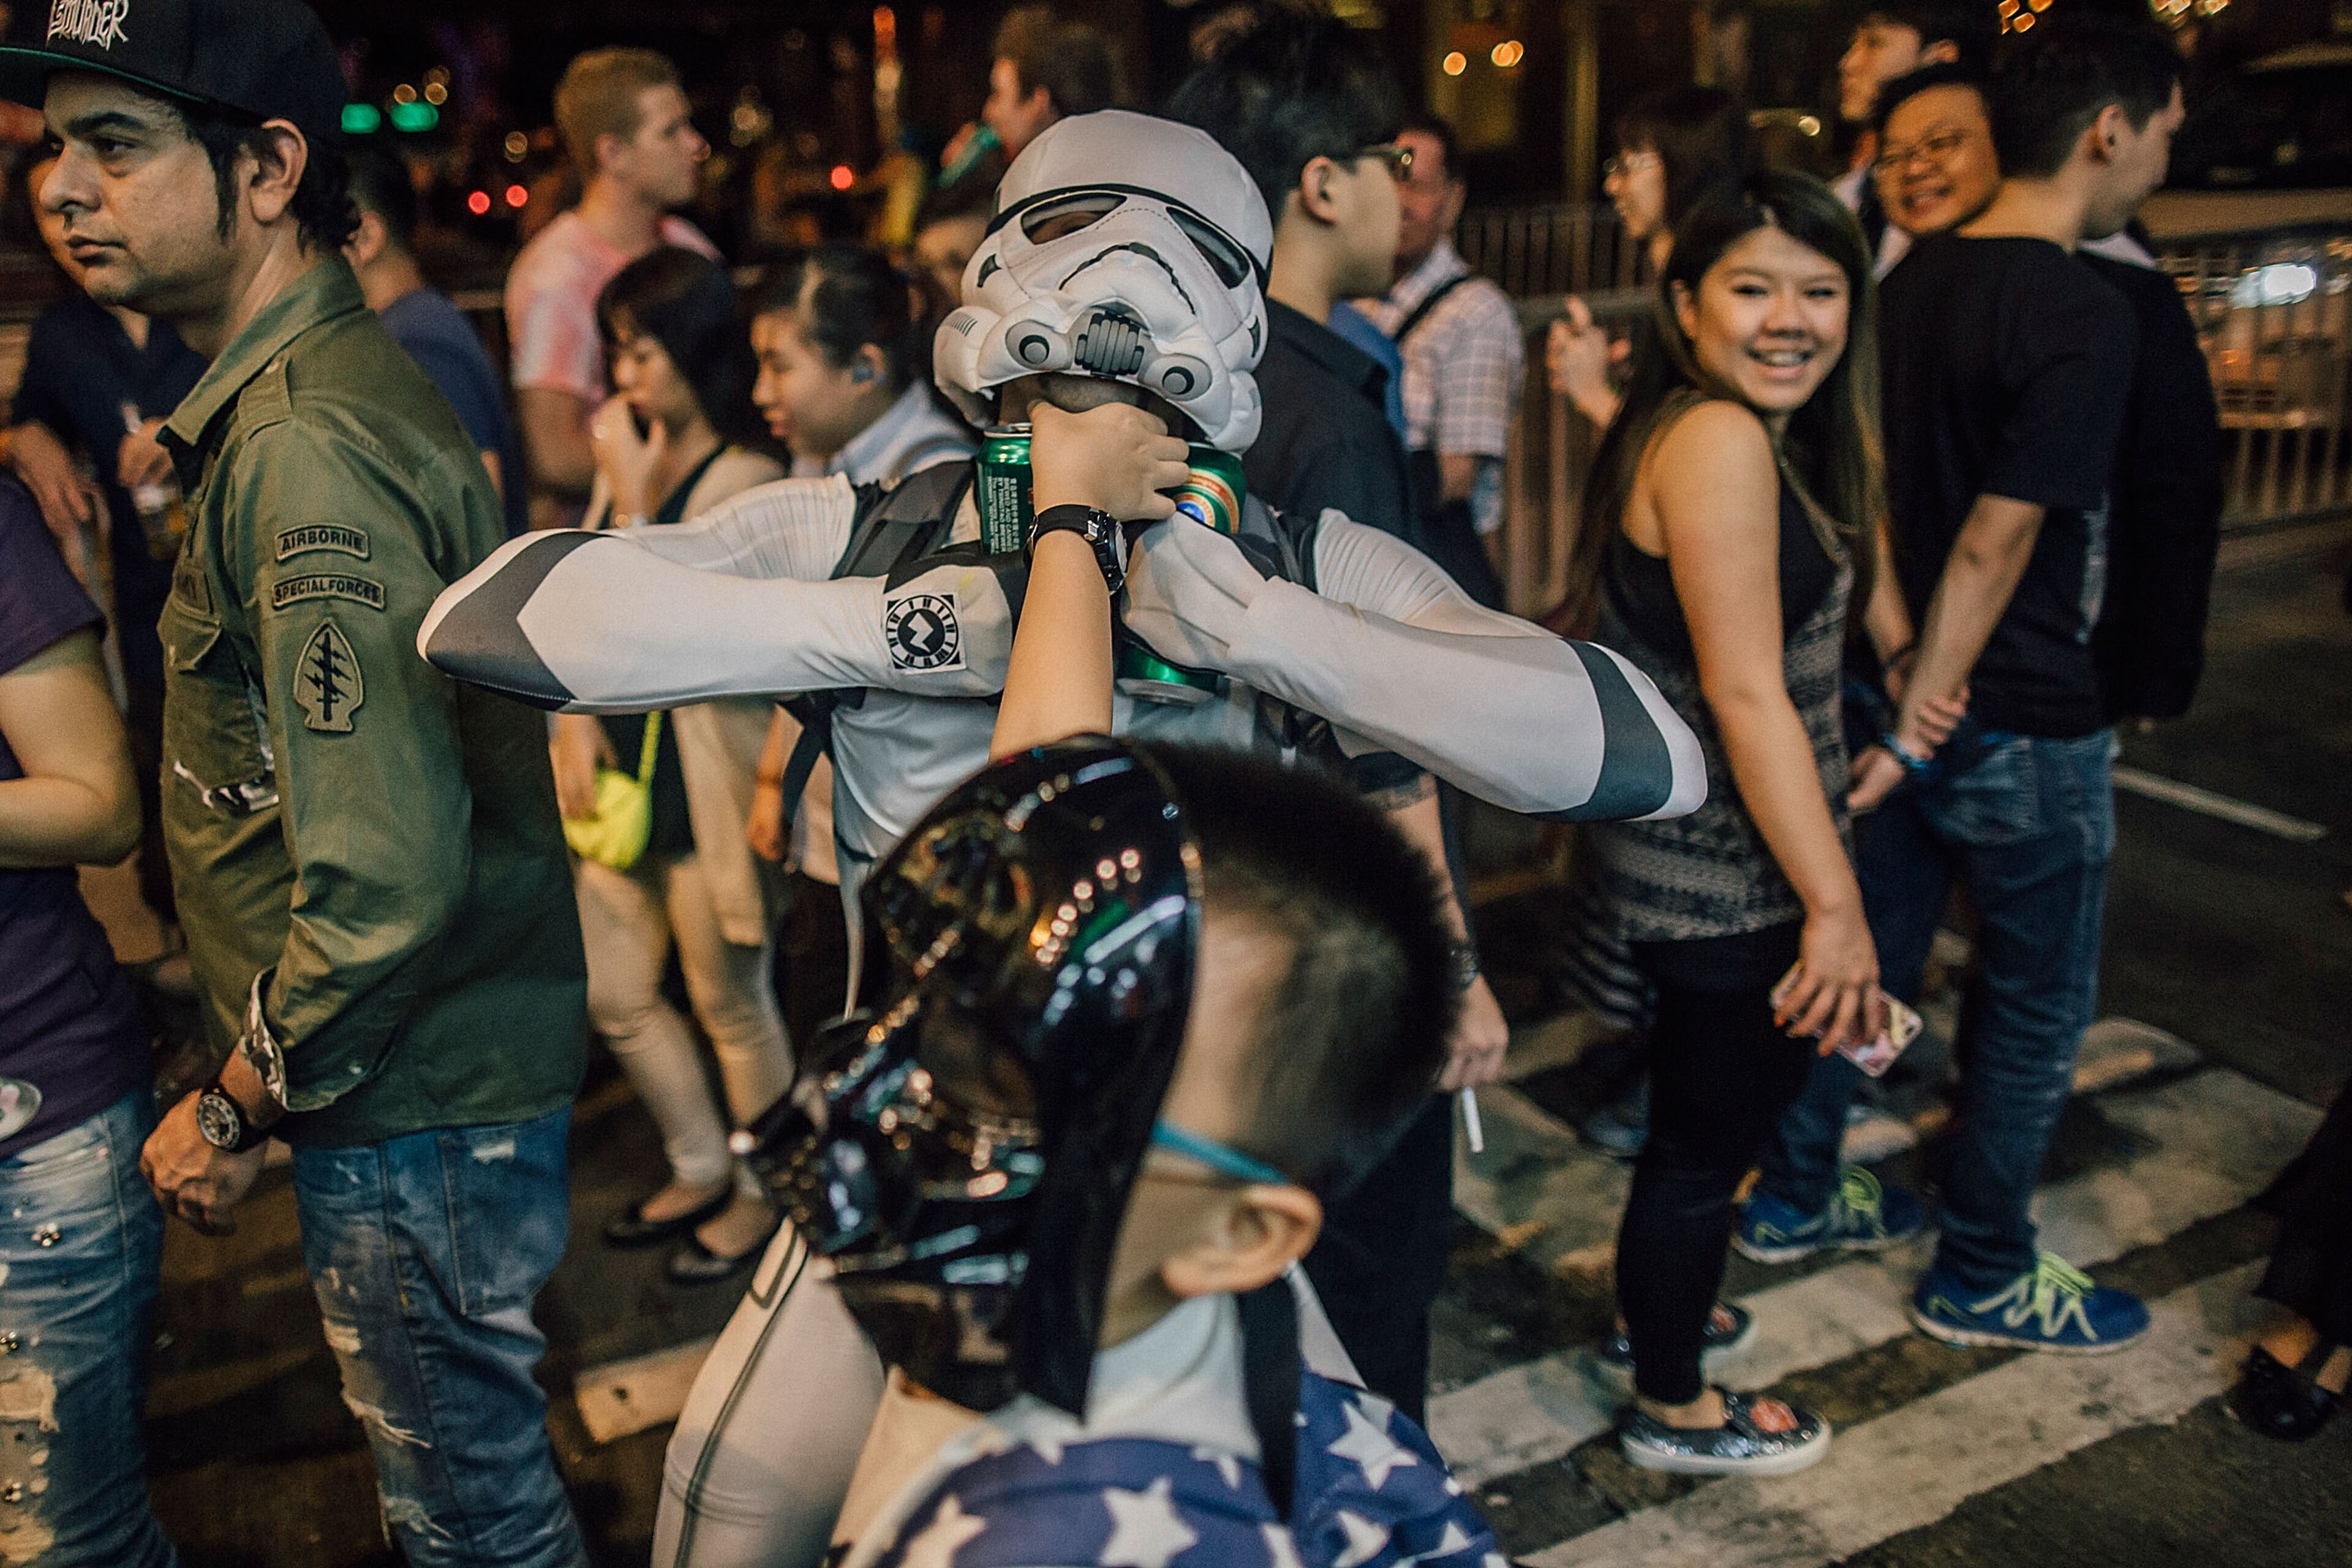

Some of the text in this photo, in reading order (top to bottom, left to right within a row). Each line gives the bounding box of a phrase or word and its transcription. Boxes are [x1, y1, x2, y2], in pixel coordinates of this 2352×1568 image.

[282, 529, 363, 551] AIRBORNE
[276, 579, 380, 602] SPECIAL FORCES
